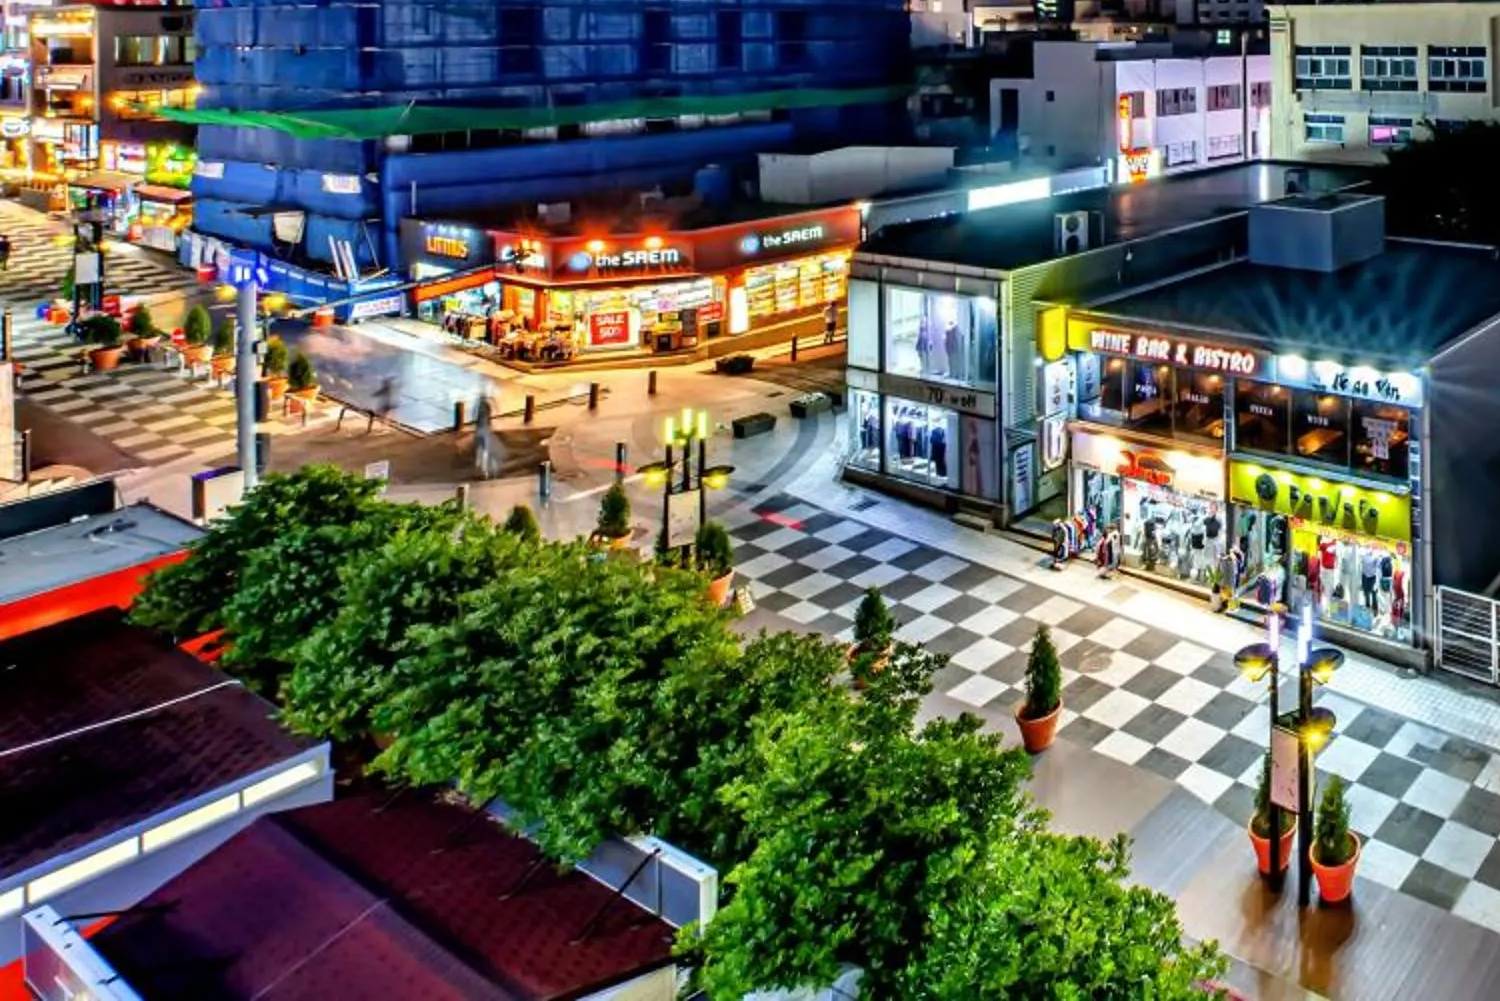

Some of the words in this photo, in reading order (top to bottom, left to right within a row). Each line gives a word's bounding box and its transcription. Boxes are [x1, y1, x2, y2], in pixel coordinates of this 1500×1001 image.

[762, 233, 782, 248] the
[783, 226, 823, 242] SAEM
[596, 253, 620, 267] the
[622, 248, 679, 266] SAEM
[595, 315, 625, 326] SALE
[1090, 330, 1131, 354] WINE
[1136, 336, 1170, 361] BAR
[1175, 343, 1188, 366] &
[1194, 346, 1255, 374] BISTRO
